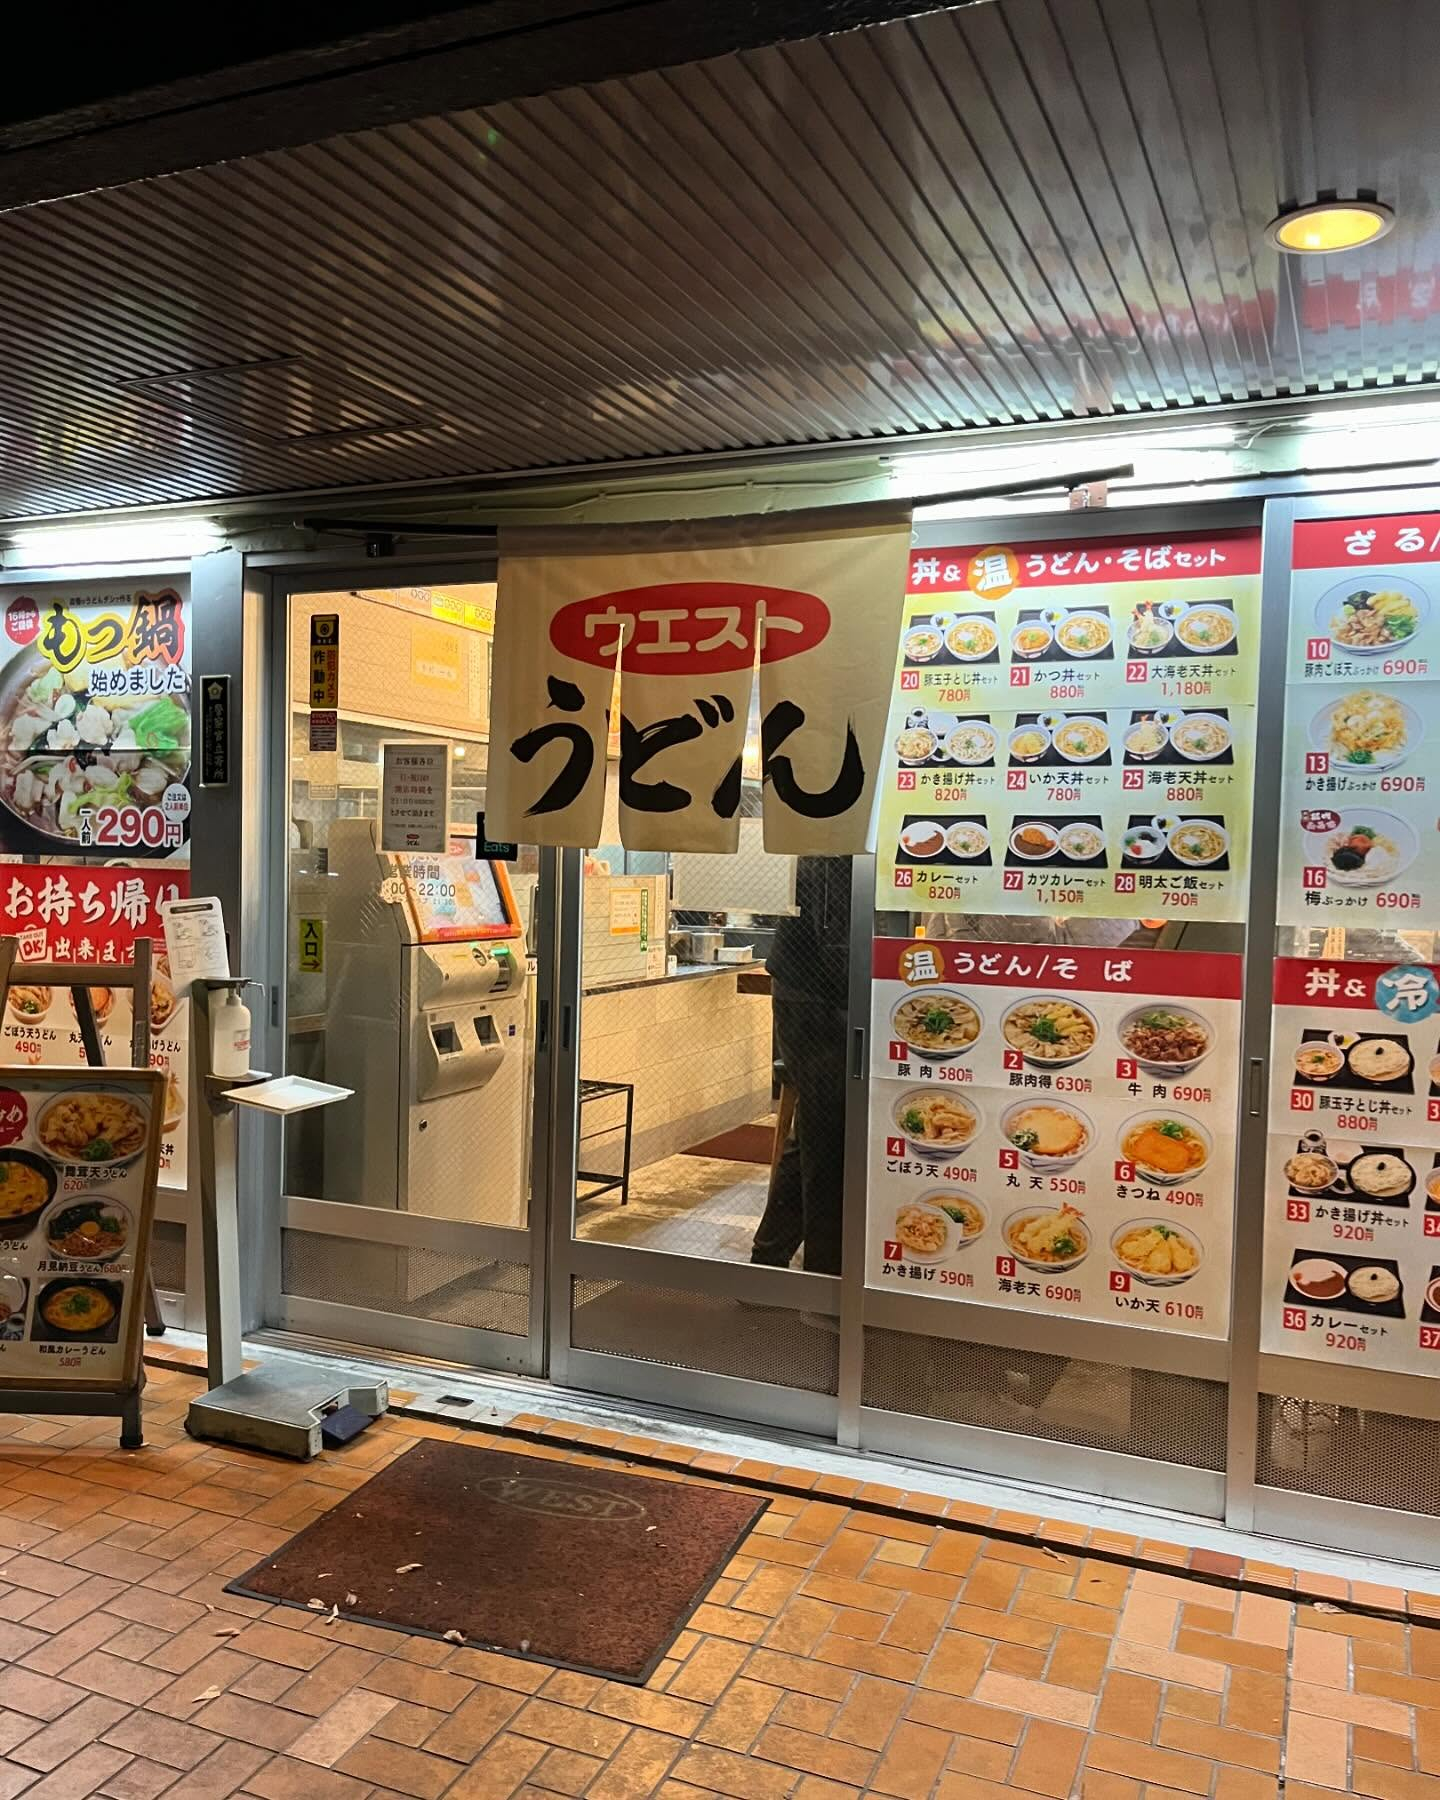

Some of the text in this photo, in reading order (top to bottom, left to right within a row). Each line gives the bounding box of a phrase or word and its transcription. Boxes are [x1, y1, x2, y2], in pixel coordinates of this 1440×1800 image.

[975, 554, 1012, 592] 温
[1026, 544, 1226, 578] うどん・そばセット
[43, 593, 180, 666] もつ鍋
[584, 599, 804, 657] ウエスト
[1309, 641, 1329, 658] 10
[90, 668, 185, 694] 始めました
[313, 649, 325, 704] 作動中
[902, 673, 919, 689] 20
[1011, 668, 1101, 685] 21 かつ丼セット
[1127, 664, 1236, 682] 22 大海老天丼セット
[509, 674, 865, 819] うどん
[1308, 755, 1327, 772] 13
[899, 772, 996, 789] 23 かき揚げ丼セット
[1008, 771, 1110, 789] 24 いか天丼セット
[1124, 770, 1234, 788] 25 海老天丼セット
[1305, 776, 1377, 792] かき揚げぶっかけ
[81, 806, 182, 845] 一人前 290円
[484, 842, 510, 854] Eats
[391, 863, 441, 881] 営業時間
[896, 870, 979, 886] 26 カレーセット
[1005, 872, 1106, 889] 27 カツカレーセット
[1305, 870, 1324, 886] 16
[1116, 875, 1224, 892] 28 明太ご飯セット
[1304, 890, 1368, 907] 梅ぶっかけ
[304, 922, 318, 957] 入口
[903, 950, 1134, 982] 温 うどん/そば
[1304, 967, 1429, 1011] 丼& 冷
[3, 1027, 57, 1041] ごぼう天うどん
[894, 1044, 903, 1058] 1
[1008, 1053, 1019, 1068] 2
[1120, 1061, 1132, 1077] 3
[897, 1062, 932, 1079] 豚肉
[1009, 1072, 1052, 1089] 豚肉得
[1127, 1082, 1167, 1099] 牛肉
[1292, 1092, 1413, 1116] 30 豚玉子とじ丼セット
[891, 1140, 901, 1155] 4
[1003, 1152, 1015, 1167] 5
[64, 1166, 128, 1179] 舞茸天うどん
[886, 1159, 940, 1178] ごぼう天
[1119, 1164, 1131, 1180] 6
[1006, 1173, 1044, 1190] 丸天
[1116, 1184, 1161, 1201] きつね
[1288, 1203, 1409, 1228] 33 かき揚げ丼セット
[888, 1244, 899, 1259] 7
[37, 1260, 101, 1272] 月見納豆うどん
[882, 1262, 936, 1281] かき揚げ
[1000, 1259, 1011, 1275] 8
[998, 1277, 1041, 1297] 海老天
[1114, 1274, 1126, 1290] 9
[1115, 1296, 1160, 1314] いか天
[1285, 1311, 1389, 1337] 36 カレーセット
[39, 1345, 107, 1355] 和風カレーうどん
